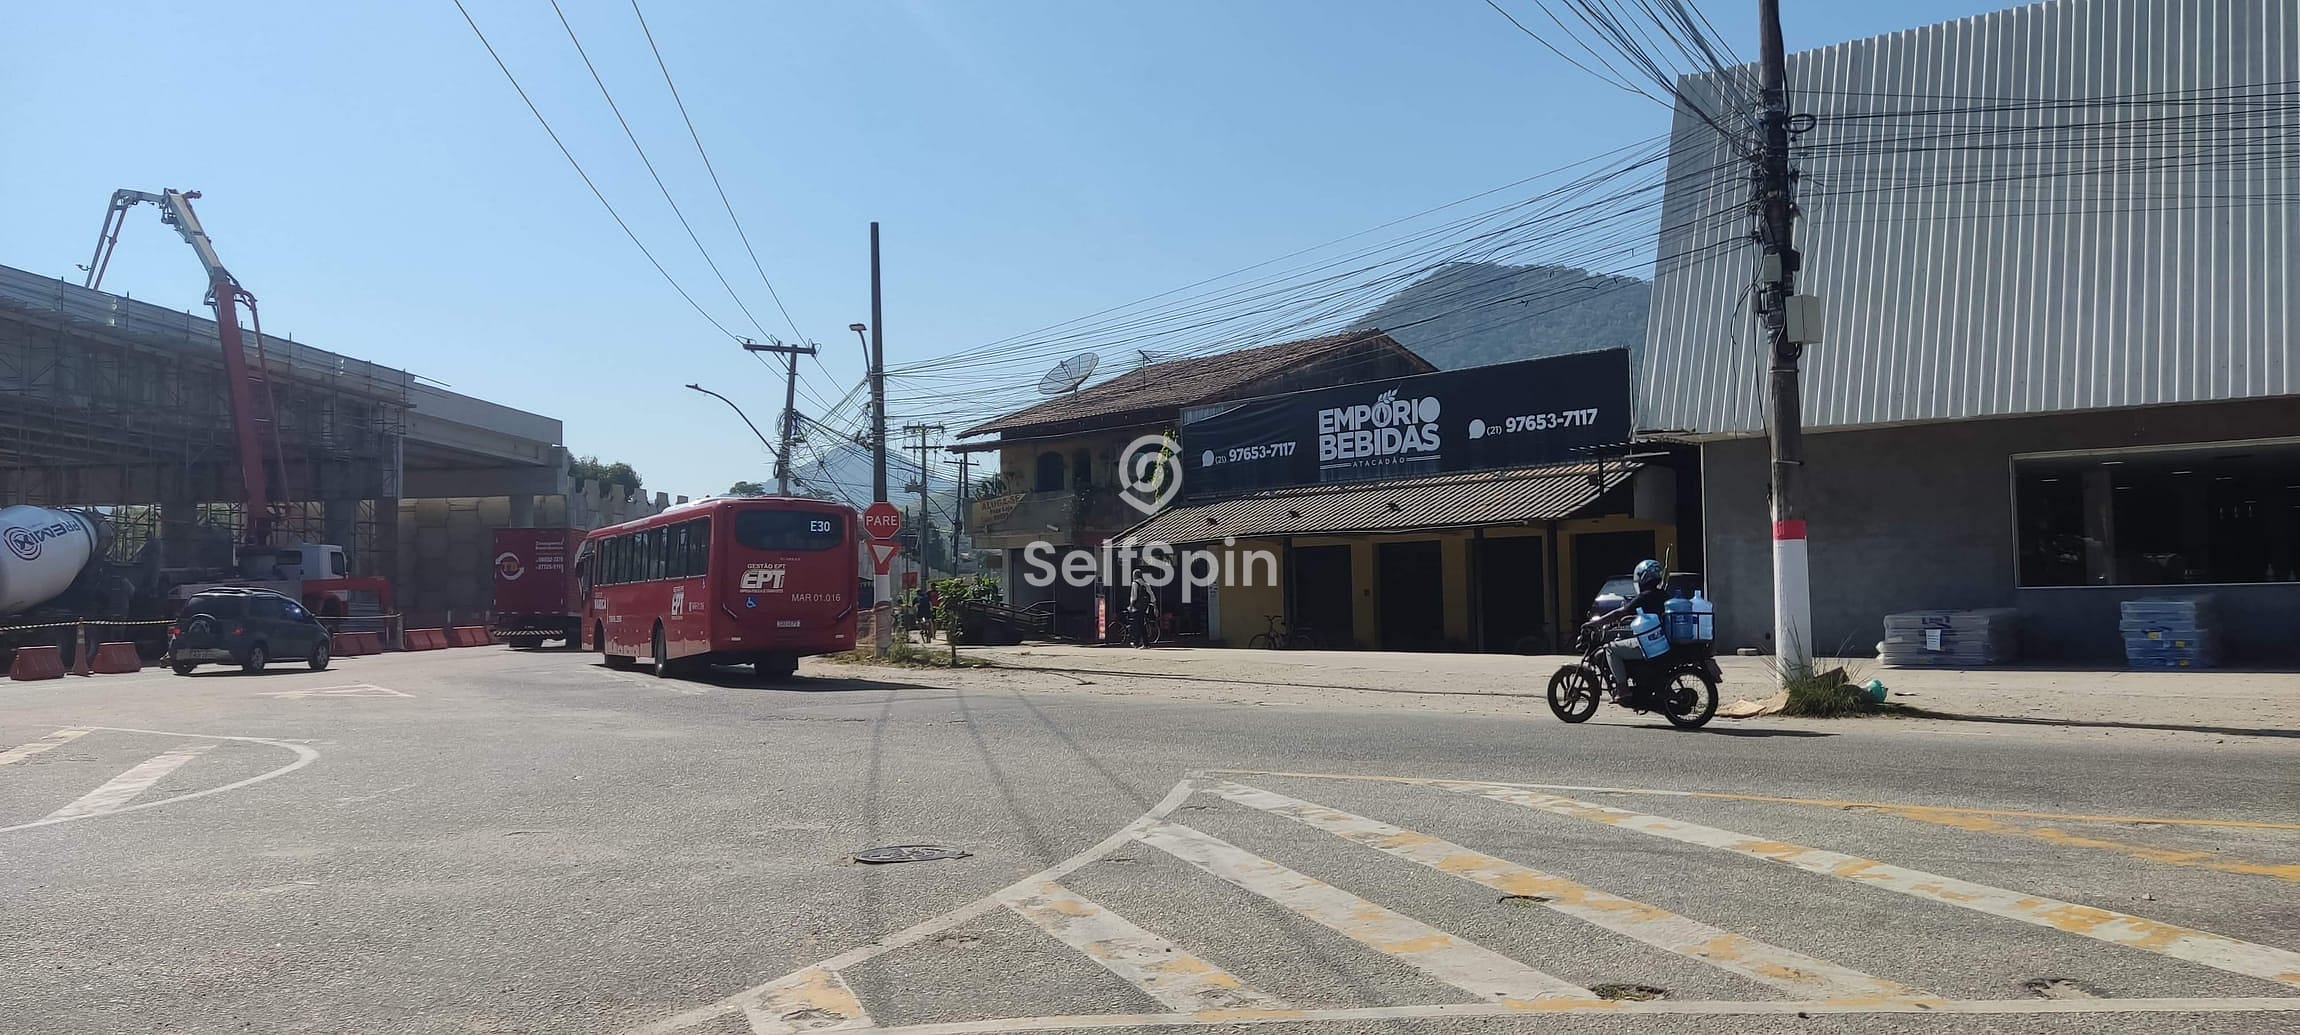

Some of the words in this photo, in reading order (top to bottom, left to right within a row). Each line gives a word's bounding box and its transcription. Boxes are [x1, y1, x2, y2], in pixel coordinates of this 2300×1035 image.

[1486, 425, 1502, 436] (21)
[1505, 408, 1598, 433] 97653-7117
[1319, 423, 1441, 461] BEBIDAS
[1215, 455, 1227, 464] (21)
[1228, 441, 1297, 462] 97653-7117
[1352, 456, 1406, 467] ATACADÃO
[810, 520, 832, 532] E30
[866, 515, 898, 526] PARE
[741, 569, 786, 589] EPT
[791, 593, 812, 602] MAR
[813, 593, 841, 602] 01.016
